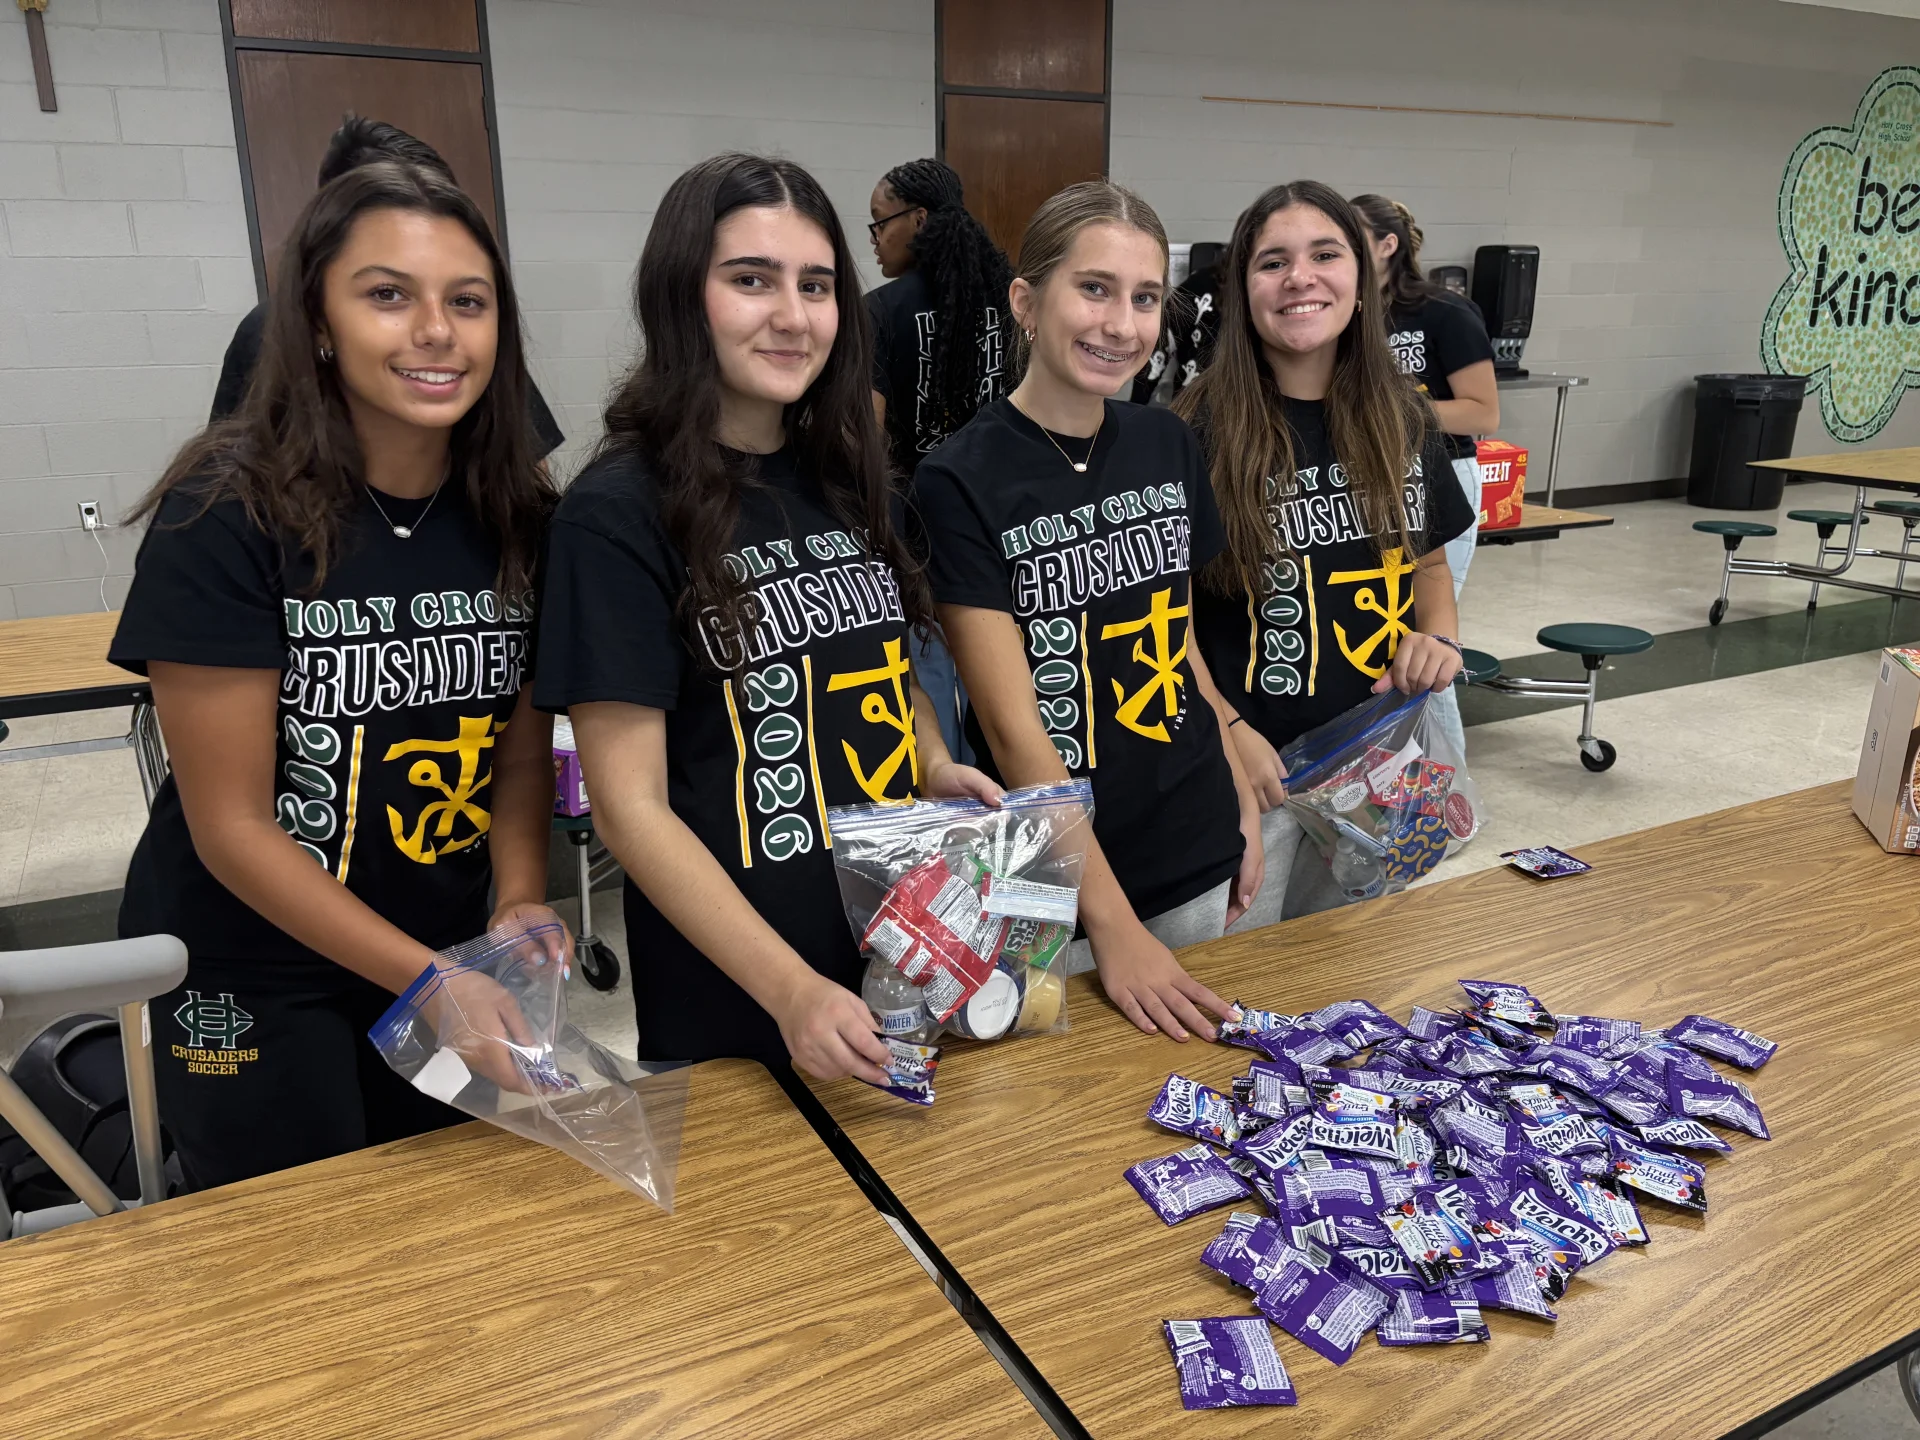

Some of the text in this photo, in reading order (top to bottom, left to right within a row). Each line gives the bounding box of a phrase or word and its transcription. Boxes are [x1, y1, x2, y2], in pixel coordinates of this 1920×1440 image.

[1001, 504, 1096, 560] HOLY
[1011, 514, 1192, 617] CRUSADERS
[1260, 558, 1305, 695] 2026
[743, 662, 813, 862] 2026
[884, 1016, 911, 1029] WATER
[171, 1044, 259, 1062] CRUSADERS
[187, 1062, 239, 1075] SOCCER
[1636, 1168, 1682, 1188] Snacks
[1649, 1165, 1677, 1179] Fruit
[1451, 1225, 1467, 1241] FRUIT
[1524, 1221, 1561, 1243] MIXED FRUIT
